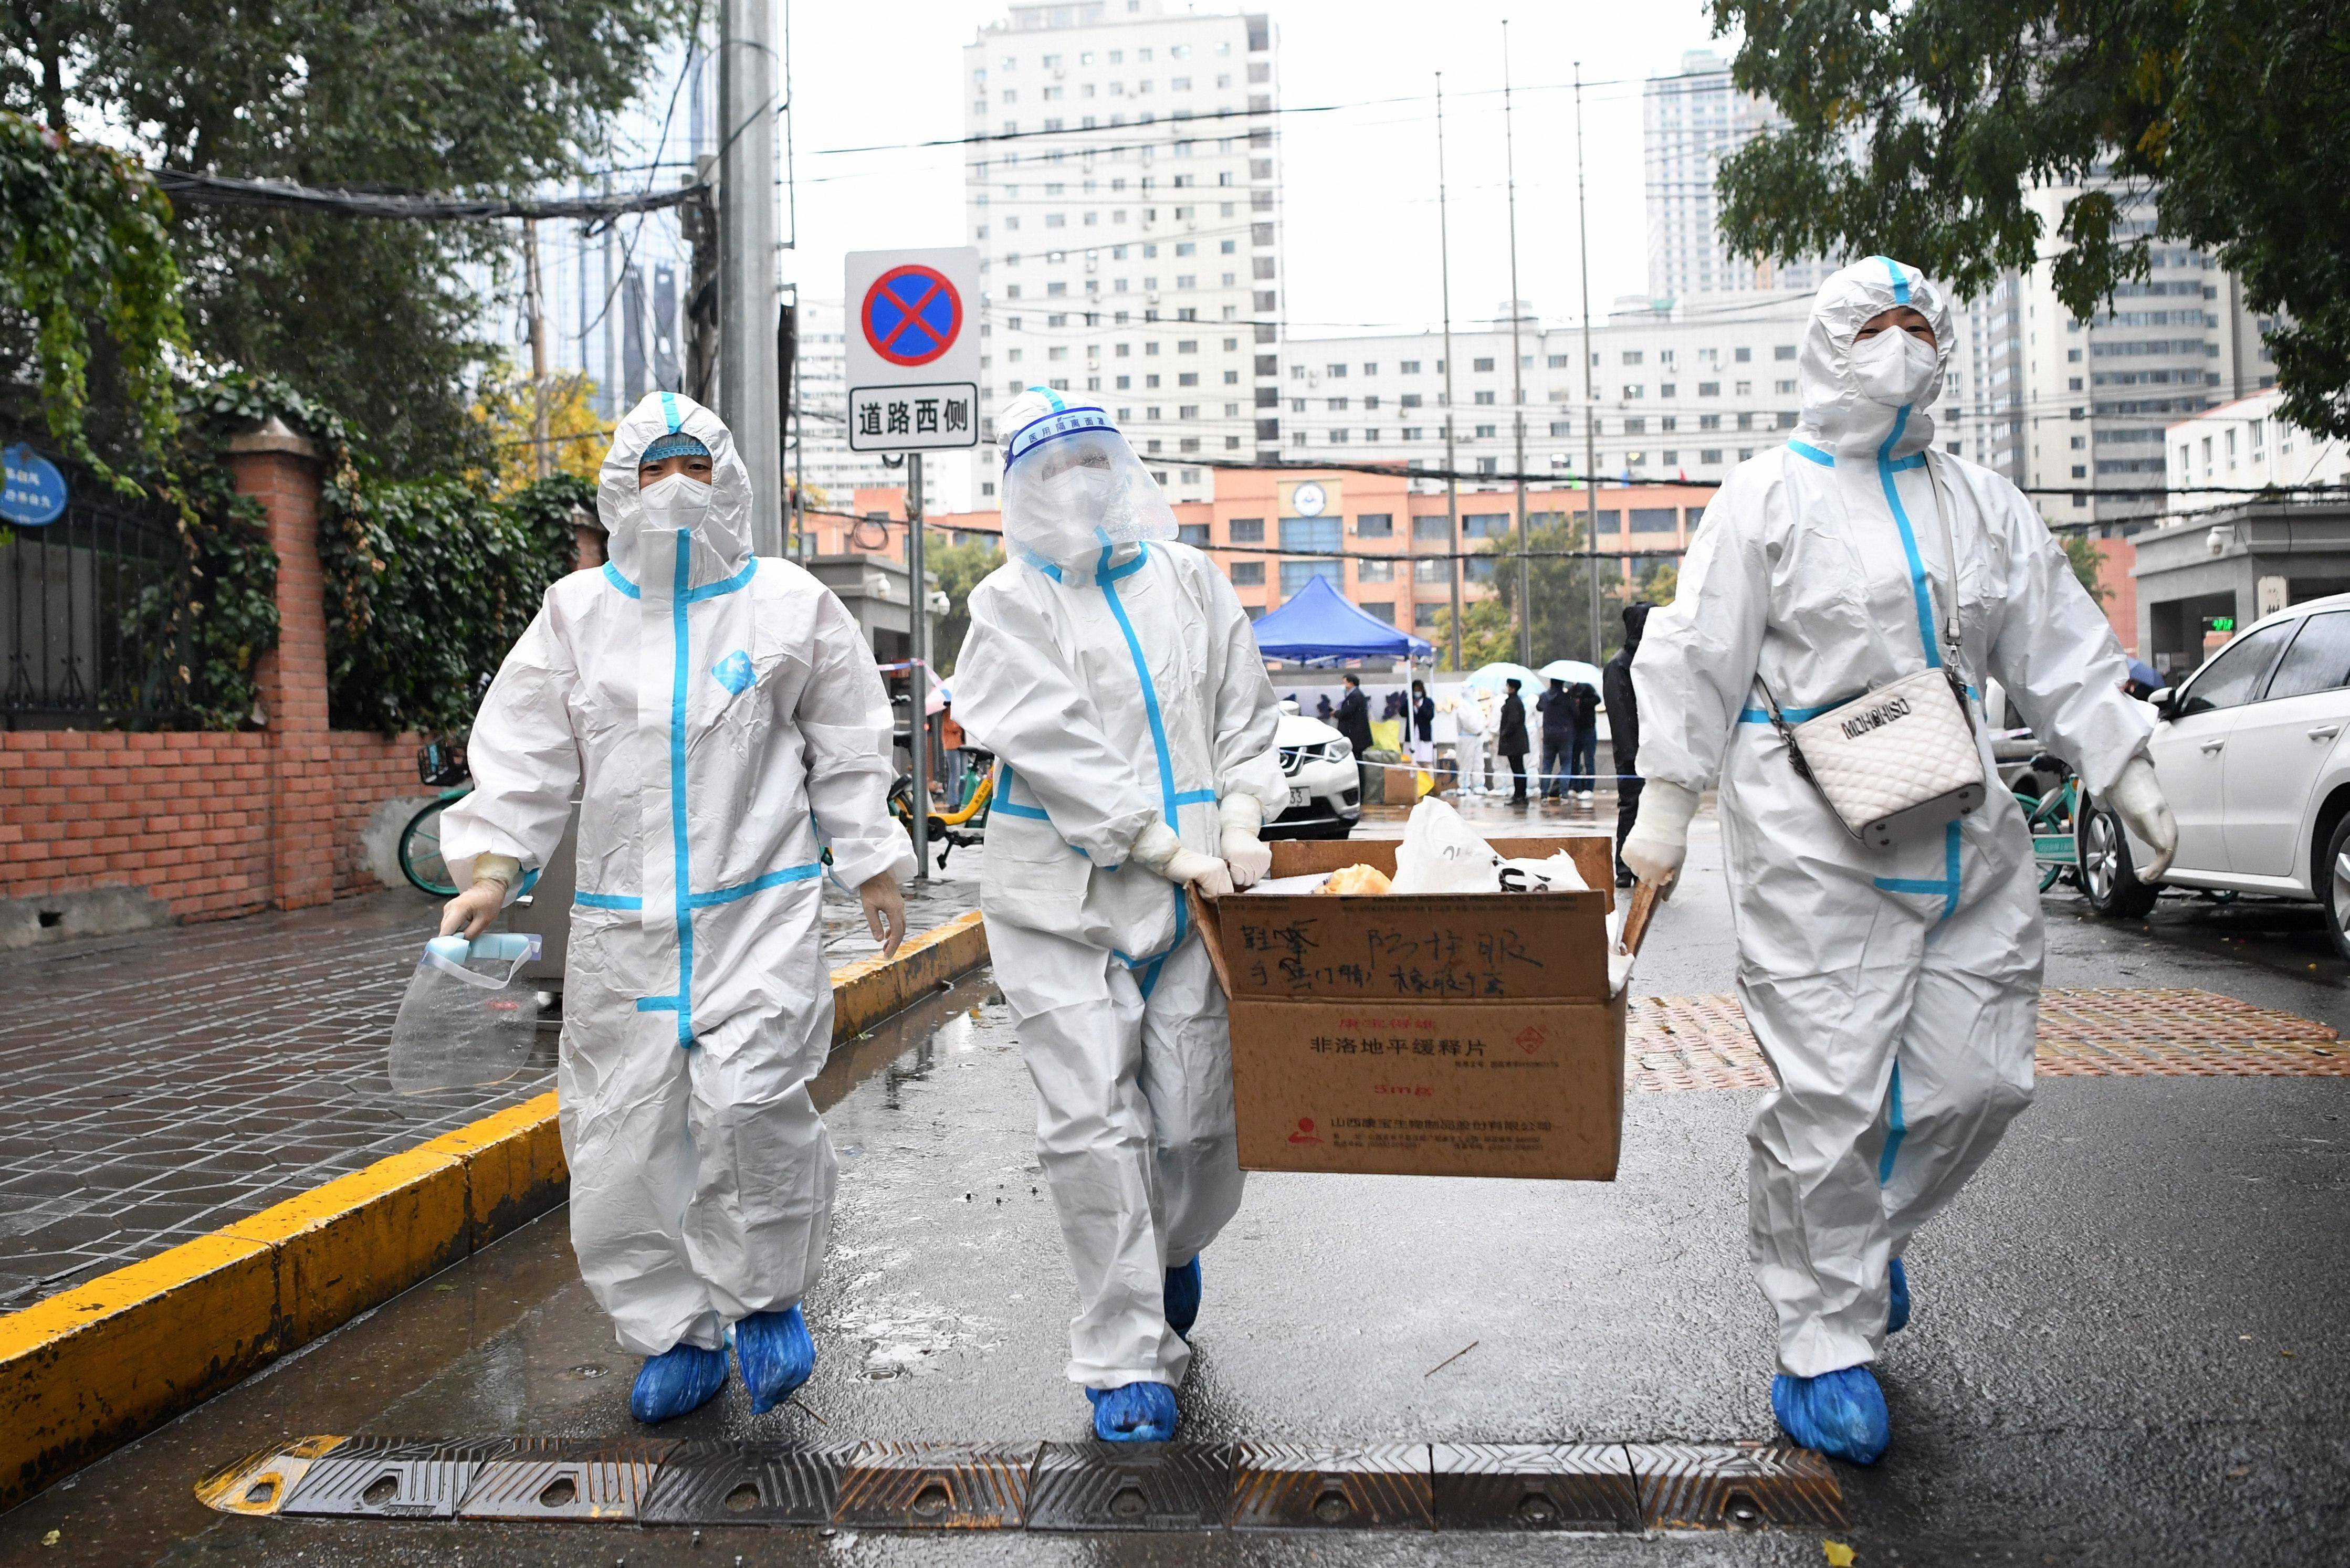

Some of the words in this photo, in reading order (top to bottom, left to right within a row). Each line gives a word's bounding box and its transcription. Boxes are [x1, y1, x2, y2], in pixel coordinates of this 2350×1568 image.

[859, 398, 968, 435] 道路西侧
[1310, 1036, 1487, 1057] 非洛地平缓释片
